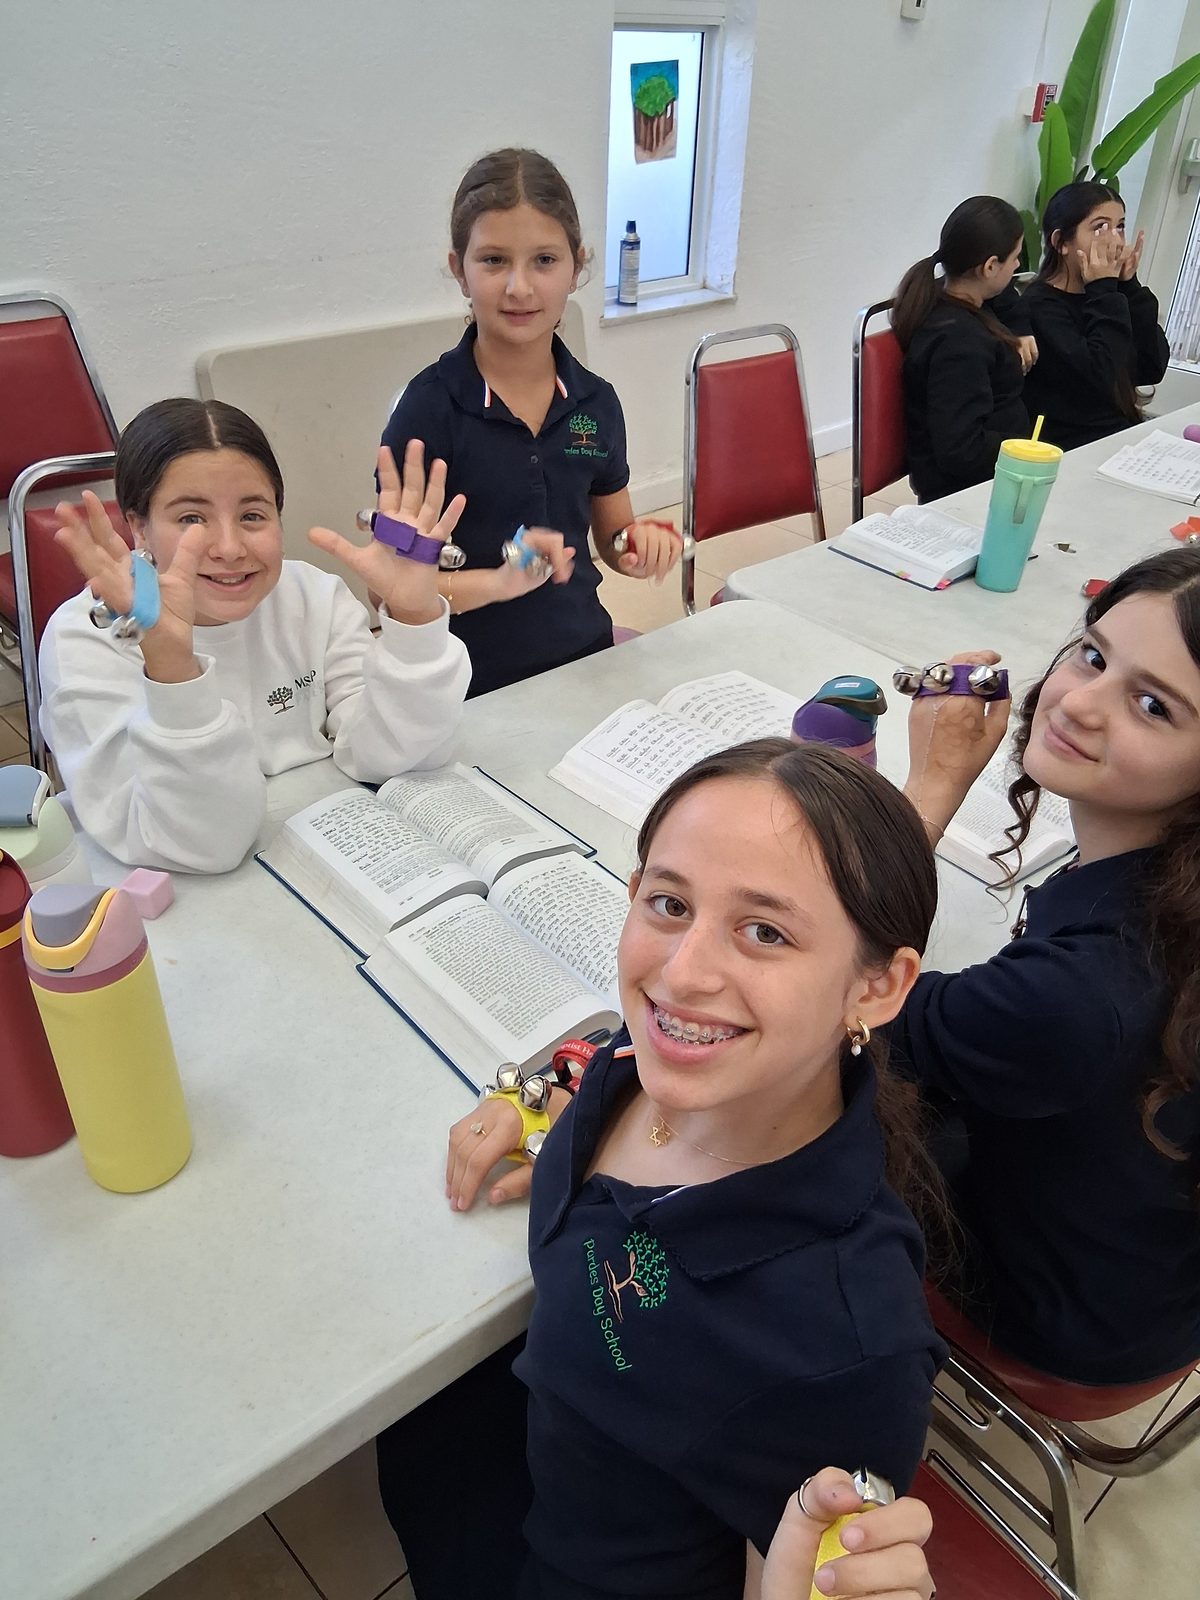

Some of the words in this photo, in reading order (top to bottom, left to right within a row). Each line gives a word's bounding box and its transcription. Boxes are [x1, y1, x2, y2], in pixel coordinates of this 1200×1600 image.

[294, 669, 317, 690] MSP
[583, 1238, 601, 1286] Pardes
[592, 1285, 606, 1317] Day
[600, 1317, 633, 1371] School
